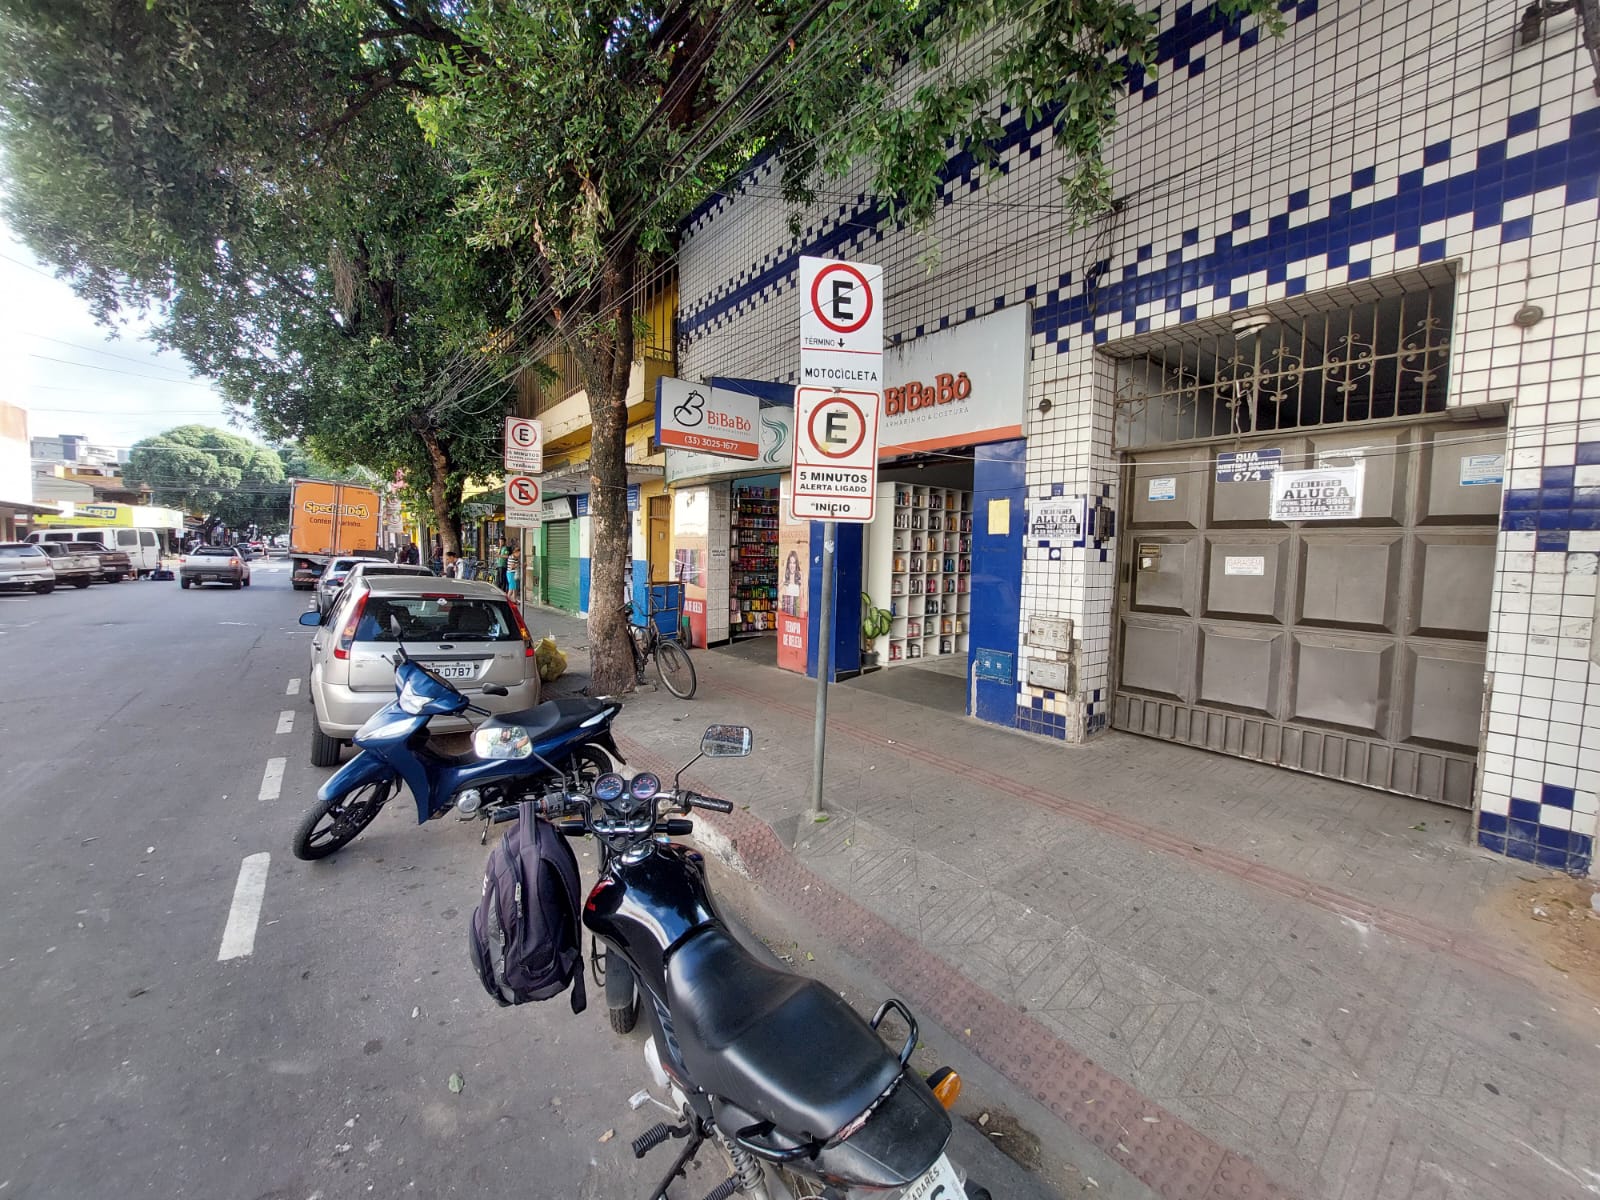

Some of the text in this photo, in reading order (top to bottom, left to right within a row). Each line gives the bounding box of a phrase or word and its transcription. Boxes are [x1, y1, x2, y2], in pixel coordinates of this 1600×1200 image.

[832, 280, 854, 321] E
[804, 367, 878, 382] MOTOCICLETA
[825, 412, 848, 444] E
[519, 428, 529, 442] E
[702, 437, 739, 451] 3025-1677
[1235, 452, 1259, 463] RUA
[800, 471, 868, 484] 5 MINUTOS
[1233, 470, 1262, 482] 674
[800, 483, 867, 493] ALERTA LIGADO
[1283, 486, 1350, 499] ALUGA
[1036, 515, 1076, 523] ALUGA
